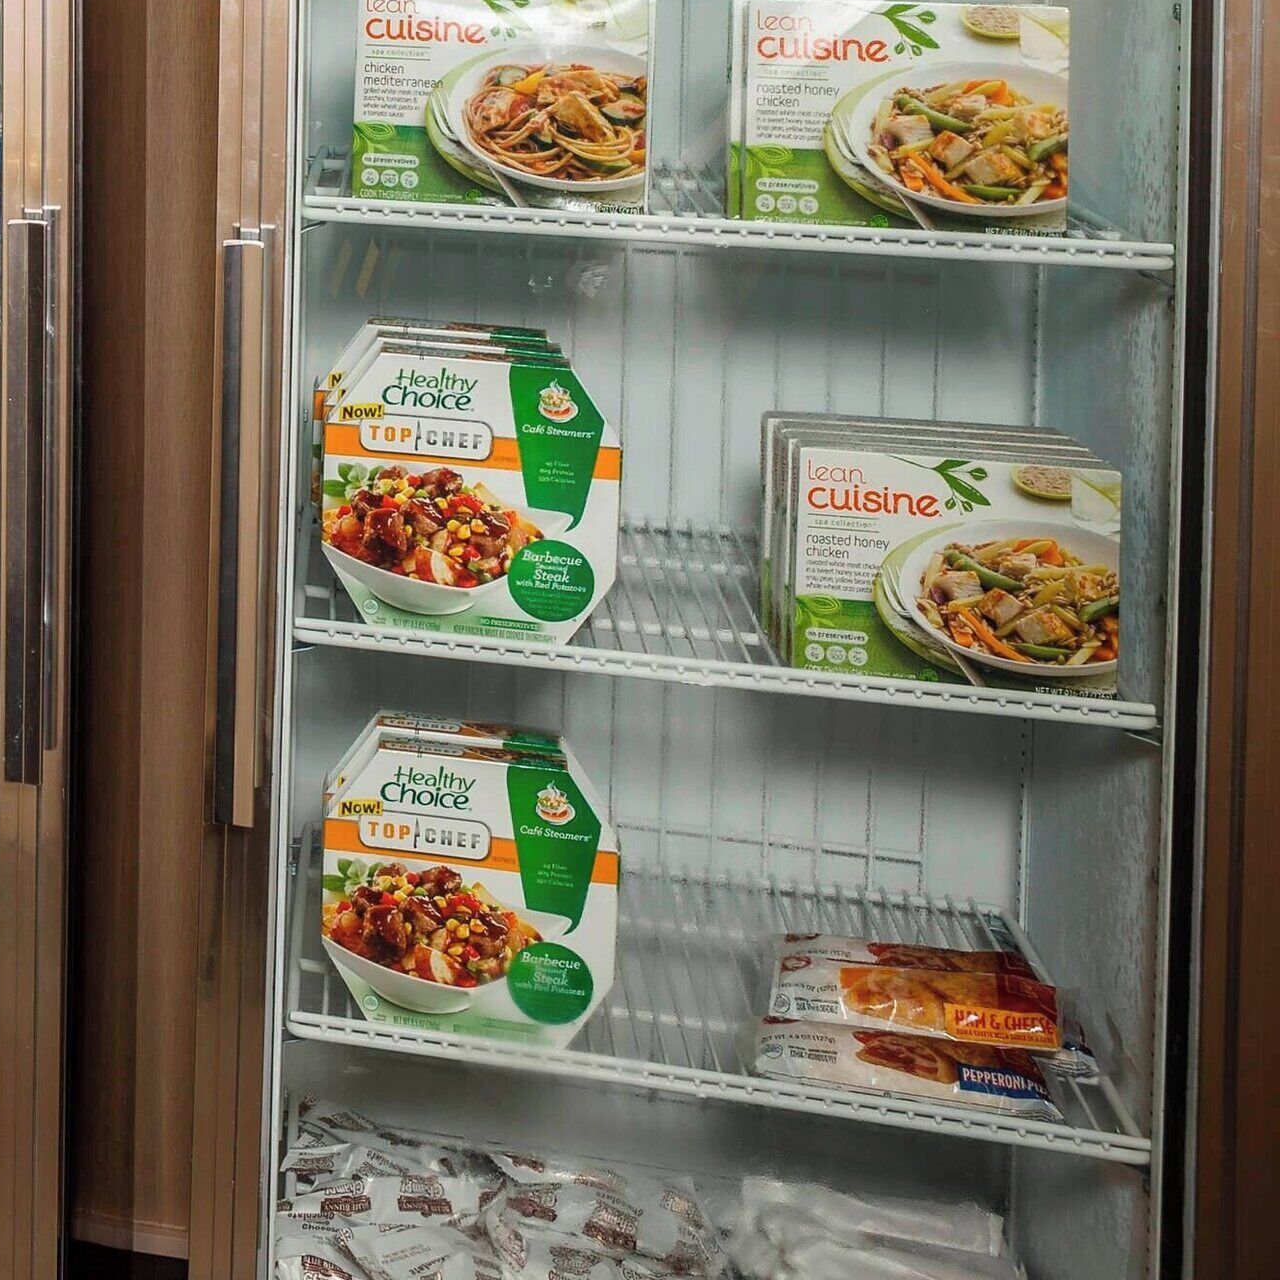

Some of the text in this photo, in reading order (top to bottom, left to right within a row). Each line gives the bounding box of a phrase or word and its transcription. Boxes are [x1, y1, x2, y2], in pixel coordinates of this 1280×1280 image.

[757, 10, 814, 30] lean
[366, 16, 485, 44] cuisine
[756, 36, 889, 63] cuisine
[365, 62, 404, 74] chicken
[364, 75, 443, 88] mediterranean
[756, 83, 840, 98] roasted honey
[756, 96, 800, 108] chicken
[396, 367, 477, 392] Healthy
[382, 385, 471, 411] Choice
[343, 405, 383, 419] Now!
[370, 425, 482, 450] TOP CHEF
[523, 424, 591, 439] Café Steamers
[808, 459, 867, 484] lean
[807, 484, 939, 518] cuisine
[806, 533, 889, 550] roasted honey
[522, 549, 582, 566] Barbecue
[806, 546, 849, 559] chicken
[534, 570, 570, 583] Steak
[394, 766, 476, 793] Healthy
[380, 782, 469, 810] Choice
[342, 801, 382, 814] Now!
[368, 821, 481, 849] TOP CHEF
[521, 825, 590, 841] Café Steamers
[521, 952, 581, 969] Barbecue
[533, 973, 568, 985] Steak
[990, 1014, 1000, 1030] &
[963, 1068, 1025, 1090] PEPPERONI
